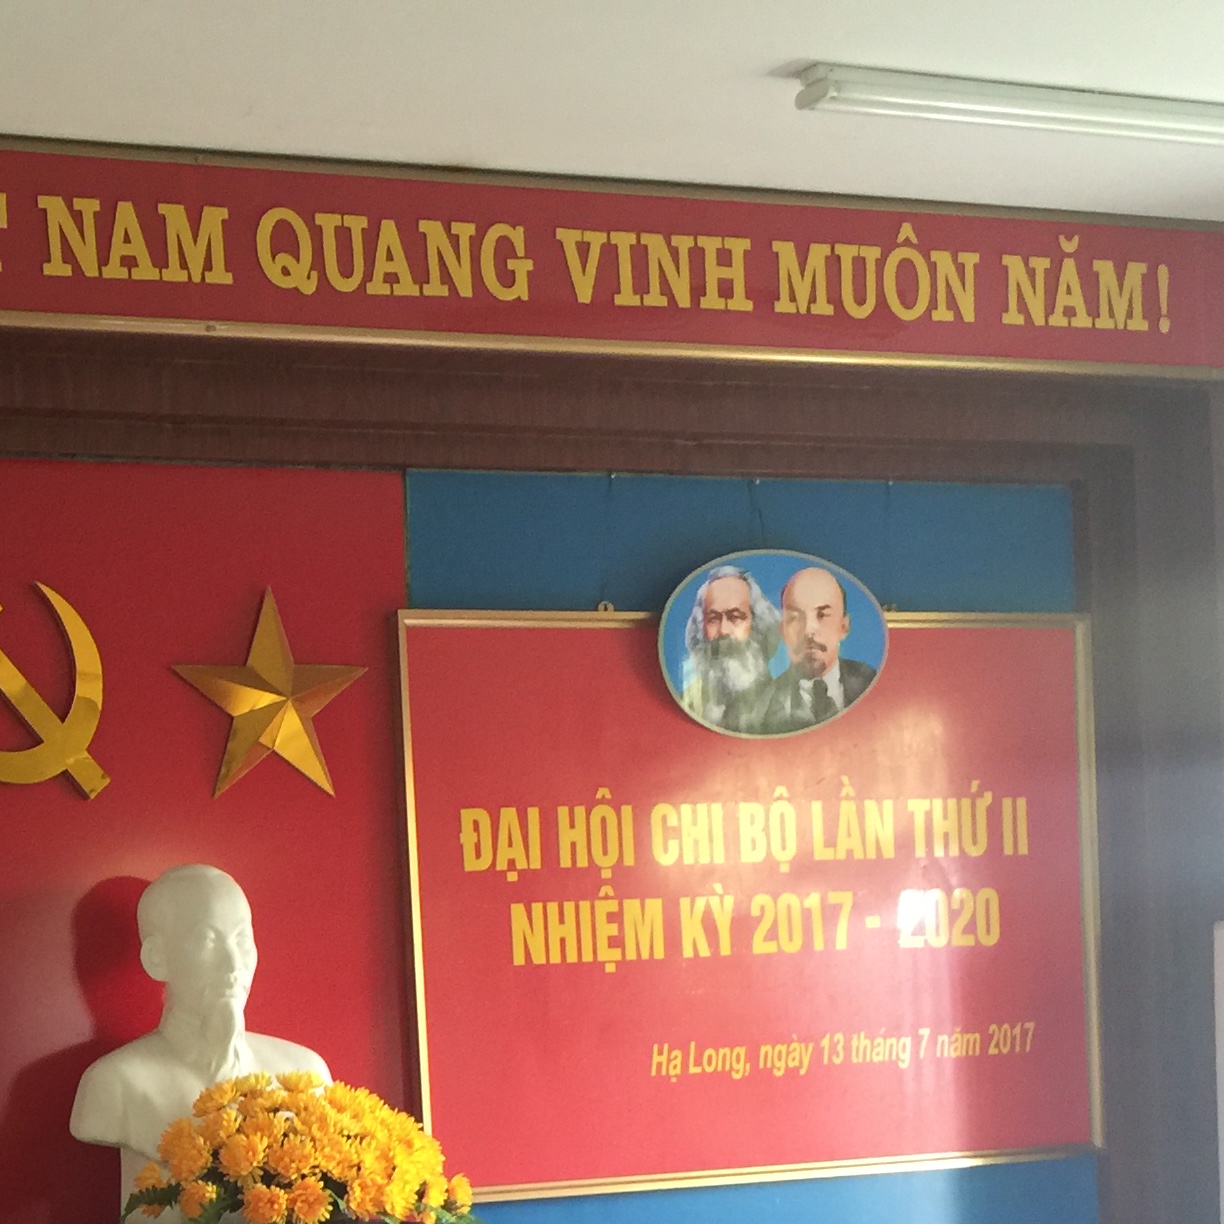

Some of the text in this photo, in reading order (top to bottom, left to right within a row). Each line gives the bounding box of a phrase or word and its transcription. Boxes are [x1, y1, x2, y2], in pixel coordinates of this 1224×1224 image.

[38, 195, 233, 285] NAM
[256, 207, 532, 302] QUANG
[556, 227, 750, 312] VINH
[772, 222, 979, 322] MUÔN
[460, 776, 1029, 881] ĐẠI HỘI CHI BỘ LẦN THỨ II
[510, 885, 664, 972] NHIỆM
[679, 883, 734, 958] KỲ
[751, 890, 854, 955] 2017
[895, 887, 1001, 948] 2020
[651, 1022, 1036, 1082] Hạ Long, ngày 13 tháng 7 năm 2017
